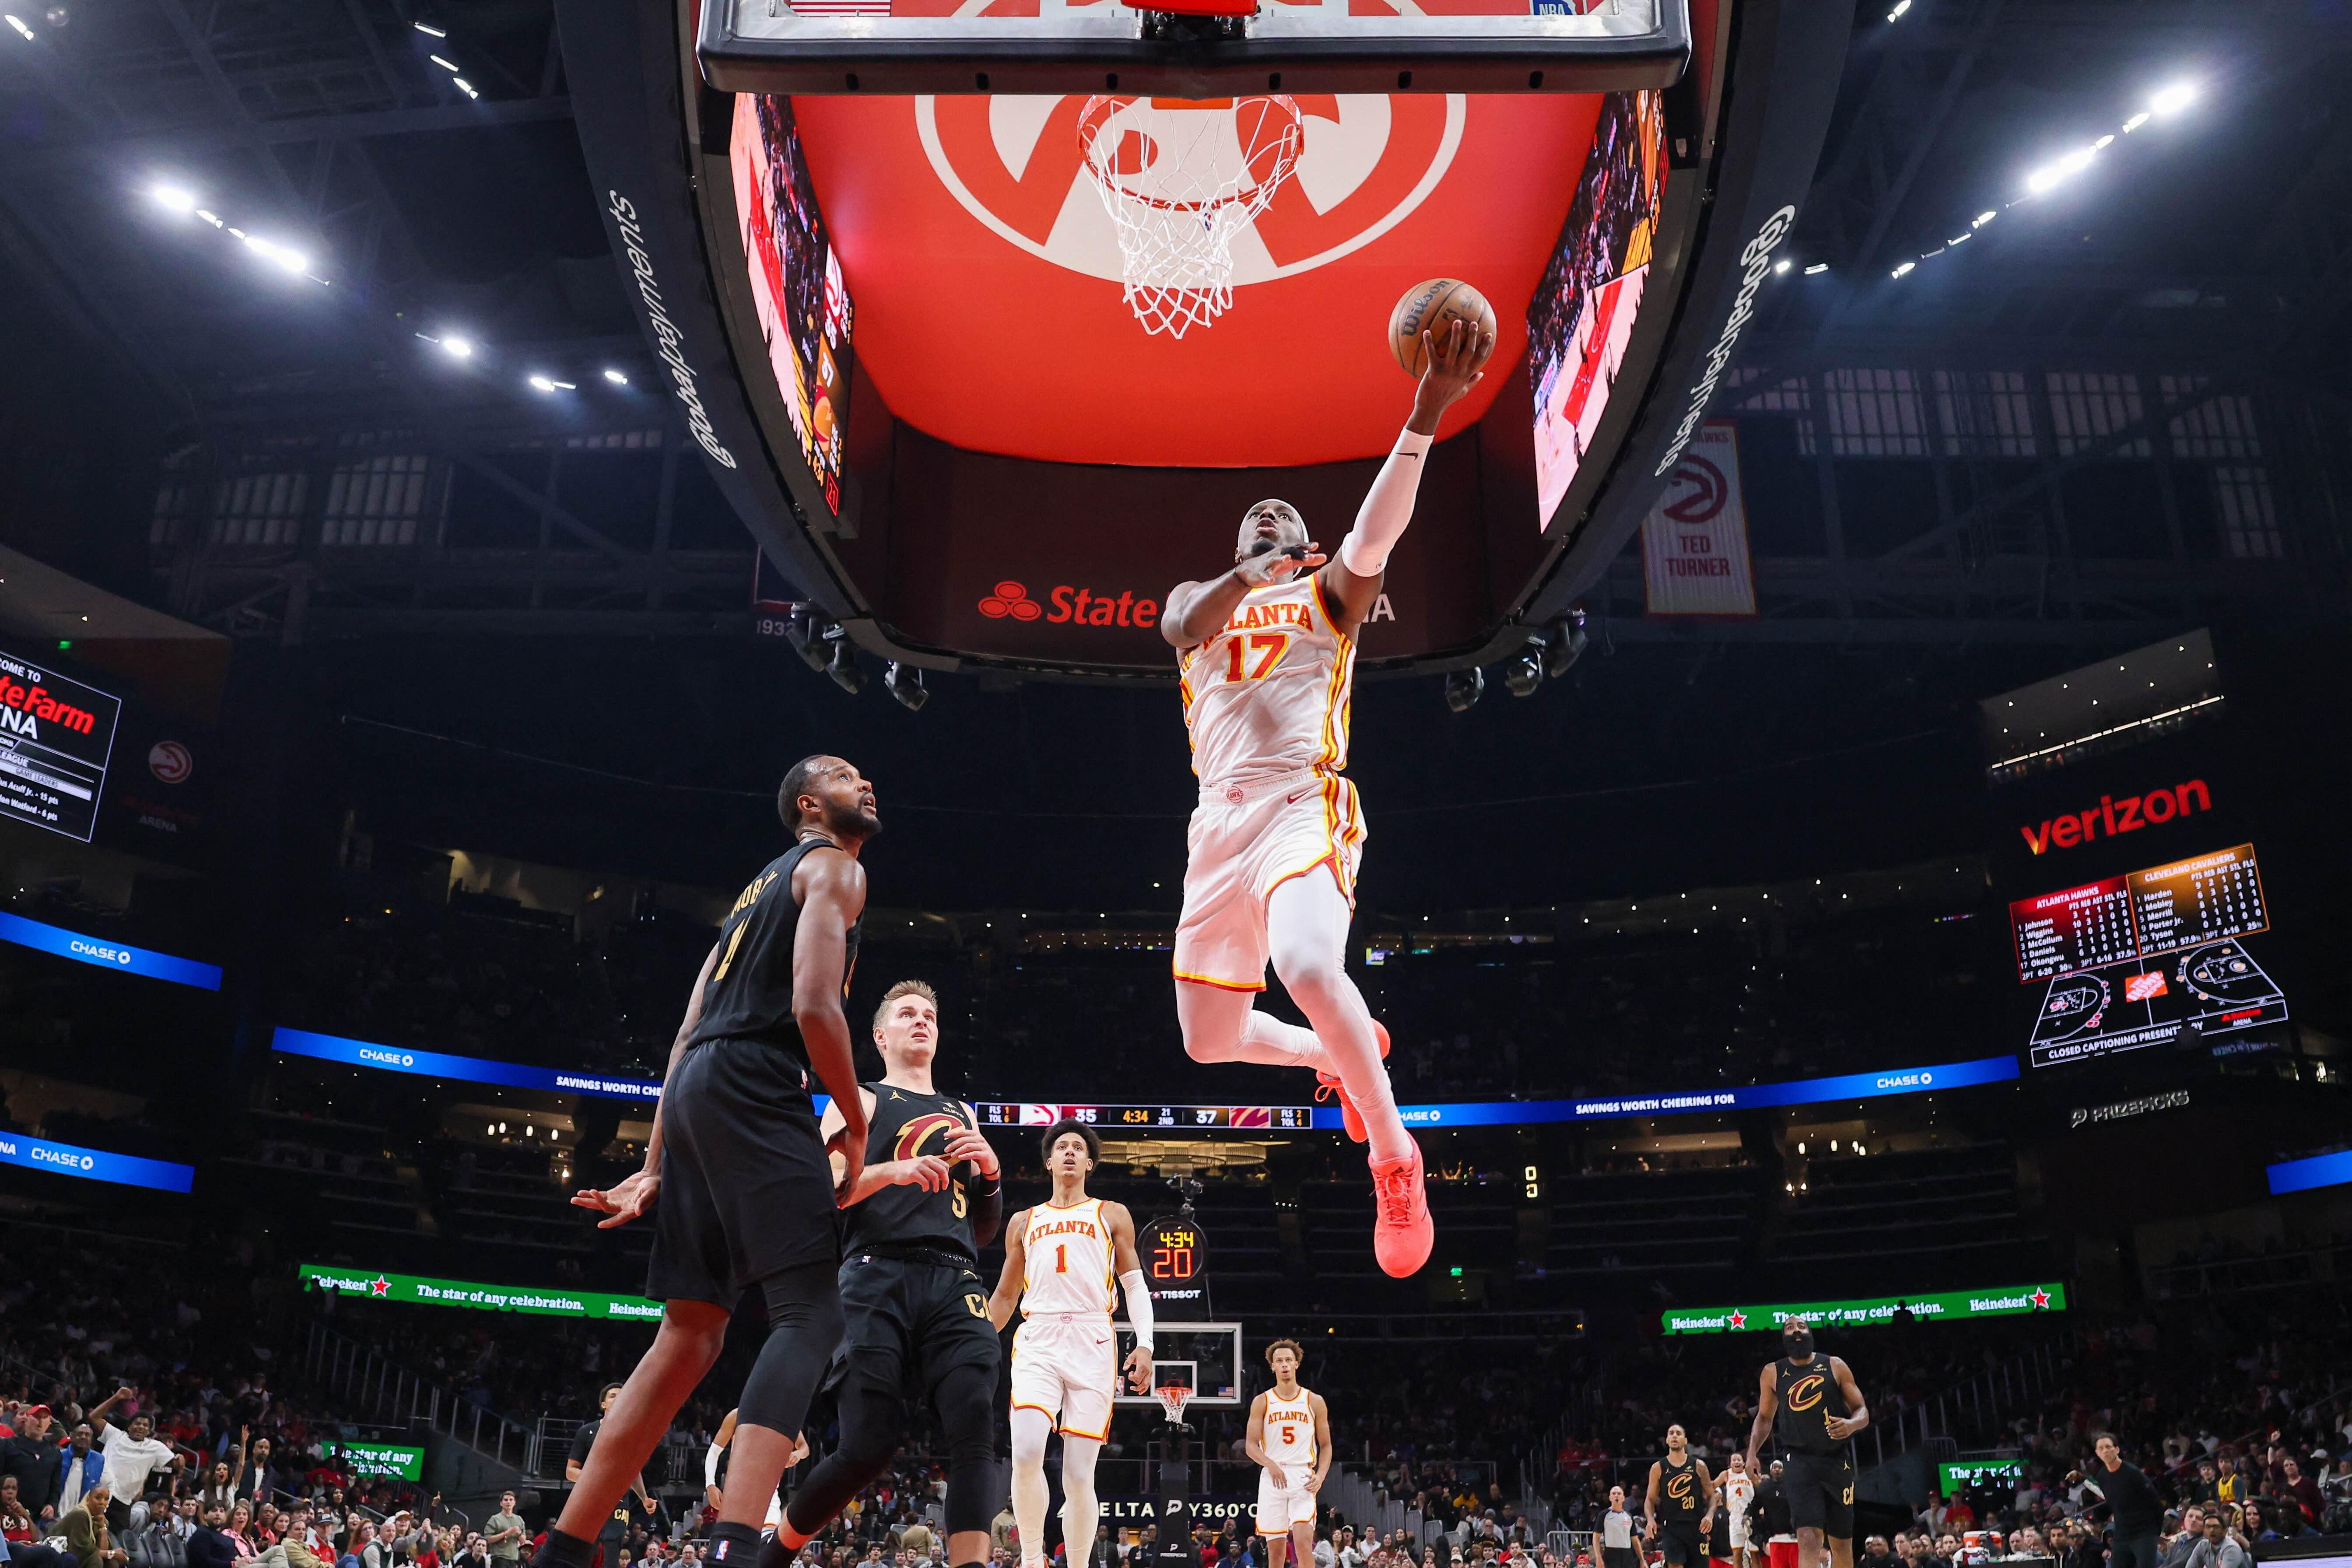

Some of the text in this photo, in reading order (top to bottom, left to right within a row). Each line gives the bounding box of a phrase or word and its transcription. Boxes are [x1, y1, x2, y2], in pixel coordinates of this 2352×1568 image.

[1402, 281, 1449, 336] Wilson
[1698, 432, 1729, 443] AWKS
[1679, 536, 1711, 553] TED
[1666, 558, 1730, 575] TURNER
[1048, 585, 1157, 629] State
[1204, 603, 1313, 650] LANTA
[1225, 633, 1289, 684] 17
[0, 657, 41, 683] OME TO
[35, 775, 58, 788] LEADERS
[2021, 779, 2211, 856] verizon
[2145, 852, 2236, 882] CLEVELAND CAVALIERS
[731, 870, 778, 919] MOBY
[2037, 886, 2099, 909] ATLANTA HAWKS
[2117, 890, 2127, 899] FLS
[2144, 889, 2173, 902] Harden
[2145, 899, 2173, 911] Mobley
[2147, 908, 2173, 921] Merrill
[2025, 918, 2054, 932] Johnson
[2149, 919, 2173, 930] Porter
[2026, 927, 2054, 939] Wiggins
[2150, 930, 2173, 941] Tyson
[714, 913, 751, 982] 4
[2028, 935, 2063, 949] McCollum
[70, 940, 117, 961] CHASE
[2029, 946, 2056, 958] Daniels
[2031, 954, 2065, 967] Okongwu
[2049, 1045, 2081, 1059] CLOSED
[2082, 1033, 2137, 1052] CAPTIONING
[2139, 1025, 2182, 1042] PRESENT
[360, 1049, 401, 1064] CHASE
[556, 1076, 601, 1091] SAVINGS
[602, 1081, 641, 1094] WORTH
[1877, 1075, 1918, 1089] CHASE
[989, 1106, 1001, 1114] FLS
[1576, 1094, 1735, 1115] SAVINGS WORTH CHEERING FOR
[988, 1114, 1010, 1123] TOL 6
[1075, 1109, 1097, 1123] 35
[1123, 1110, 1149, 1123] 4:34
[1161, 1108, 1171, 1116] 21
[1196, 1110, 1218, 1124] 37
[1281, 1109, 1293, 1118] FLS
[1400, 1112, 1428, 1121] HASE
[1158, 1117, 1174, 1125] 2ND
[1281, 1118, 1295, 1126] TOL
[31, 1147, 80, 1167] CHASE
[952, 1179, 967, 1218] 5
[1030, 1221, 1095, 1246] ATLANTA
[1160, 1231, 1194, 1248] 4:34
[1055, 1243, 1068, 1274] 1
[1153, 1249, 1191, 1278] 20
[417, 1285, 584, 1311] The star of any celebration.
[1161, 1290, 1201, 1299] TISSOT
[609, 1303, 662, 1317] Heineken
[1970, 1297, 2027, 1311] Heineken
[1672, 1315, 1725, 1329] Heineken
[1844, 1309, 1867, 1321] any
[1787, 1375, 1824, 1411] C
[1269, 1411, 1308, 1424] ATLANTA
[1823, 1407, 1831, 1425] 1
[1283, 1426, 1295, 1445] 5
[379, 1450, 393, 1461] of
[393, 1454, 414, 1465] any
[1949, 1467, 1970, 1479] The
[1667, 1473, 1692, 1498] C
[1736, 1487, 1742, 1497] 4
[1099, 1502, 1155, 1517] ELTA
[1682, 1496, 1694, 1509] 20
